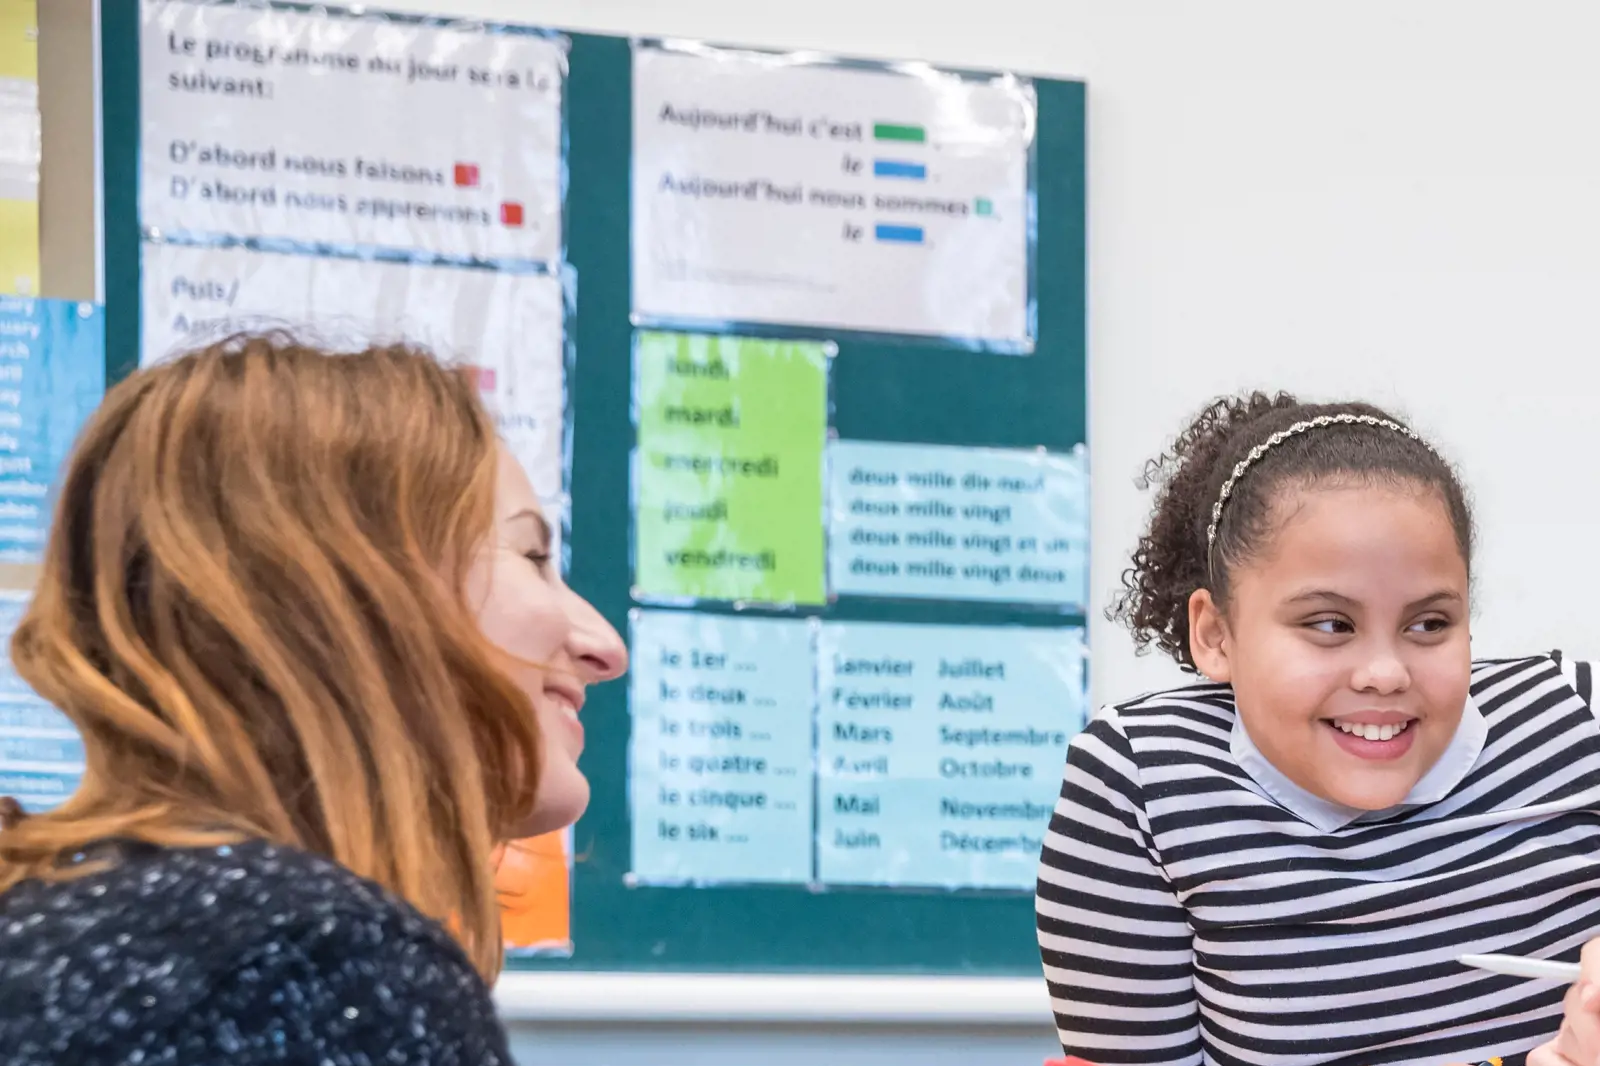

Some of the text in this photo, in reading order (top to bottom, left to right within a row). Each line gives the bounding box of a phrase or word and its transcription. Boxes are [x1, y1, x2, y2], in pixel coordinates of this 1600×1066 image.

[168, 30, 197, 56] Le
[407, 53, 458, 83] jour
[169, 139, 444, 186] D'abord nous faisons
[841, 153, 863, 176] le
[169, 175, 276, 208] D'abord
[284, 189, 348, 214] nous
[809, 189, 866, 211] nous
[874, 196, 969, 218] sommes
[842, 221, 863, 243] le
[905, 468, 953, 489] mille
[905, 500, 954, 518] mille
[961, 503, 1011, 525] vingt
[905, 529, 954, 548] mille
[961, 533, 1011, 556] vingt
[905, 559, 954, 578] mille
[961, 562, 1011, 585] vingt
[938, 658, 1006, 681] Juillet
[833, 724, 893, 743] Mars
[939, 724, 1067, 748] Septembre
[939, 758, 1034, 779] Octobre
[833, 794, 880, 816] Mai
[939, 797, 1054, 820] Novembr
